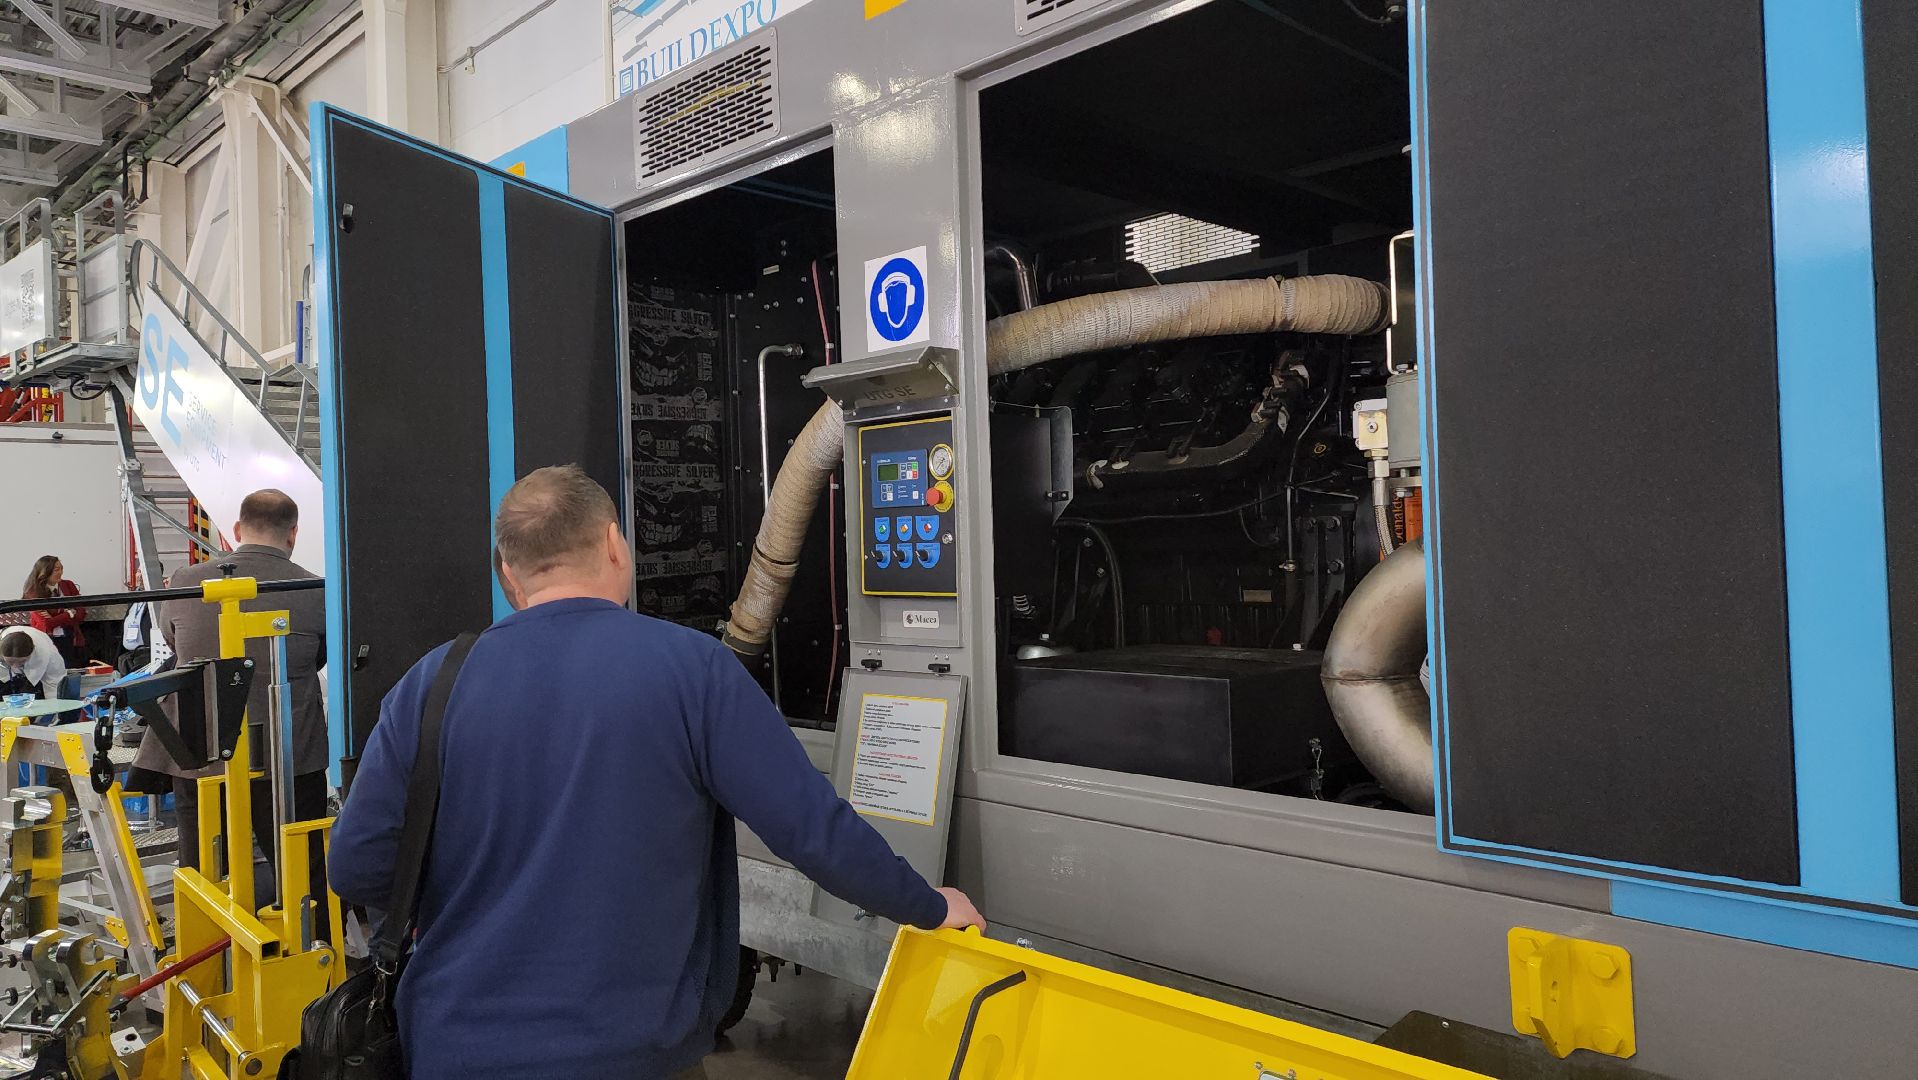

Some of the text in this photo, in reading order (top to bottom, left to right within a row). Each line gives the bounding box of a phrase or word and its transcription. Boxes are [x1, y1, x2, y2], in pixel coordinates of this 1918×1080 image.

[636, 0, 777, 87] BUILDEXPO
[140, 313, 189, 448] SE
[894, 384, 917, 397] SE
